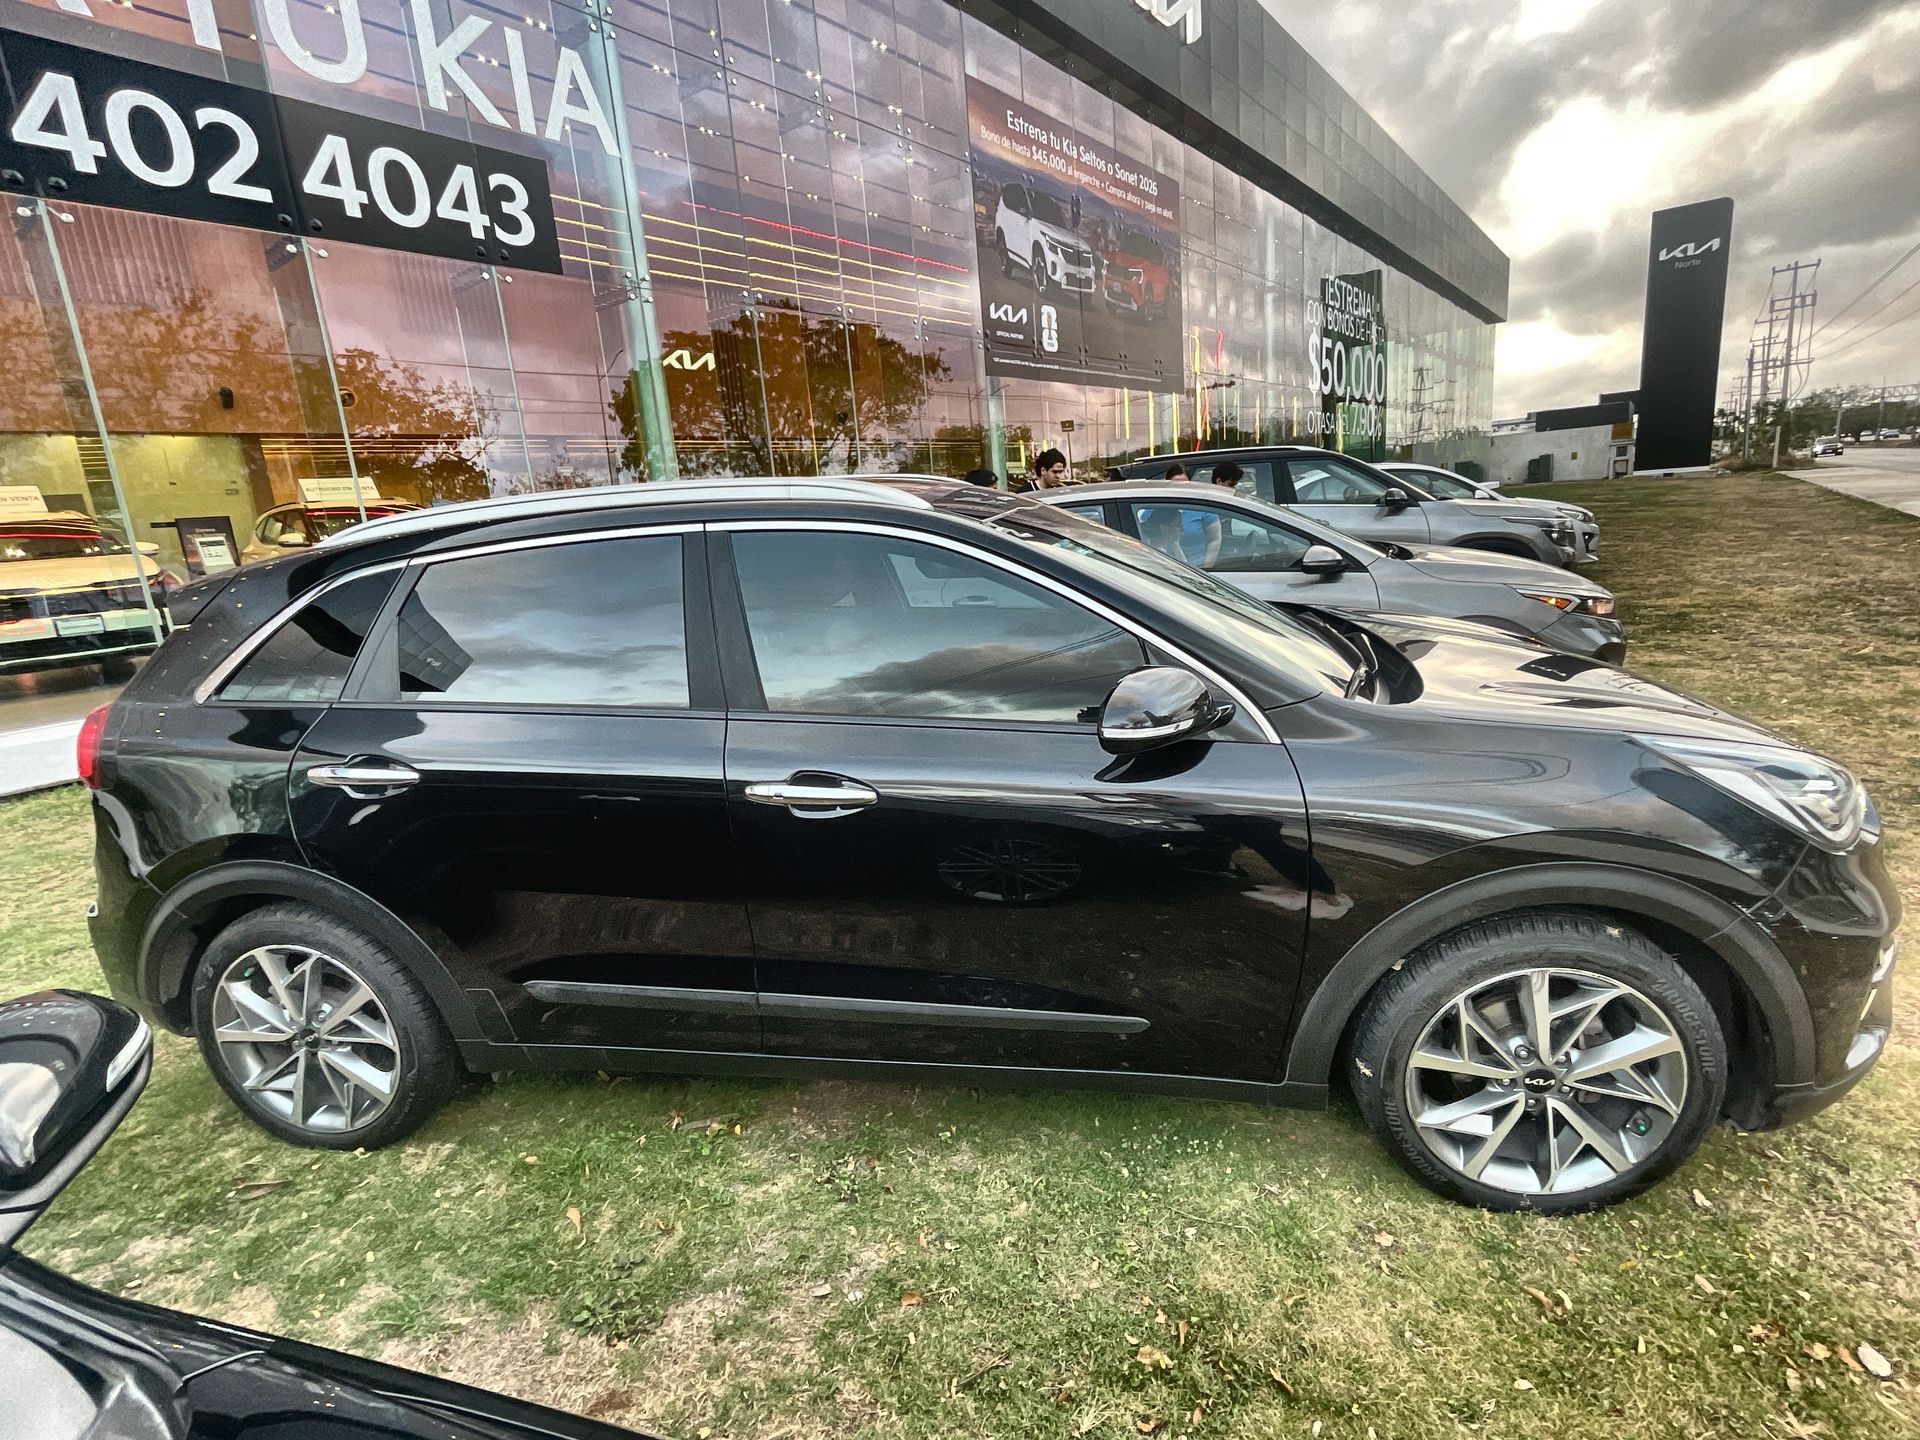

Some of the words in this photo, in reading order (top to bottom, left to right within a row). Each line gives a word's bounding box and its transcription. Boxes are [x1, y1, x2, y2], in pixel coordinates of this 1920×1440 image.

[411, 0, 621, 158] KIA
[11, 71, 274, 204] 402
[303, 134, 536, 247] 4043
[981, 125, 1001, 145] Bono
[1001, 135, 1012, 150] de
[1011, 139, 1031, 158] hasta
[1032, 145, 1067, 173] $45,000
[1105, 181, 1127, 200] Compra
[1006, 109, 1048, 145] Estrena
[1050, 131, 1061, 151] tu
[1062, 137, 1078, 159] Kia
[1079, 146, 1106, 172] Seltos
[1107, 163, 1113, 176] o
[1115, 162, 1138, 187] Sonet
[1139, 175, 1158, 196] 2026
[1658, 237, 1721, 261] KIA
[1674, 259, 1702, 269] Norte
[989, 302, 1028, 325] KIA
[1308, 300, 1327, 328] CON
[1327, 307, 1355, 338] BONOS
[1355, 318, 1365, 341] DE
[662, 349, 717, 371] KIA
[1308, 327, 1386, 406] $50,000
[1307, 410, 1315, 434] O
[1316, 411, 1336, 435] TASA
[1524, 1077, 1556, 1086] KIA
